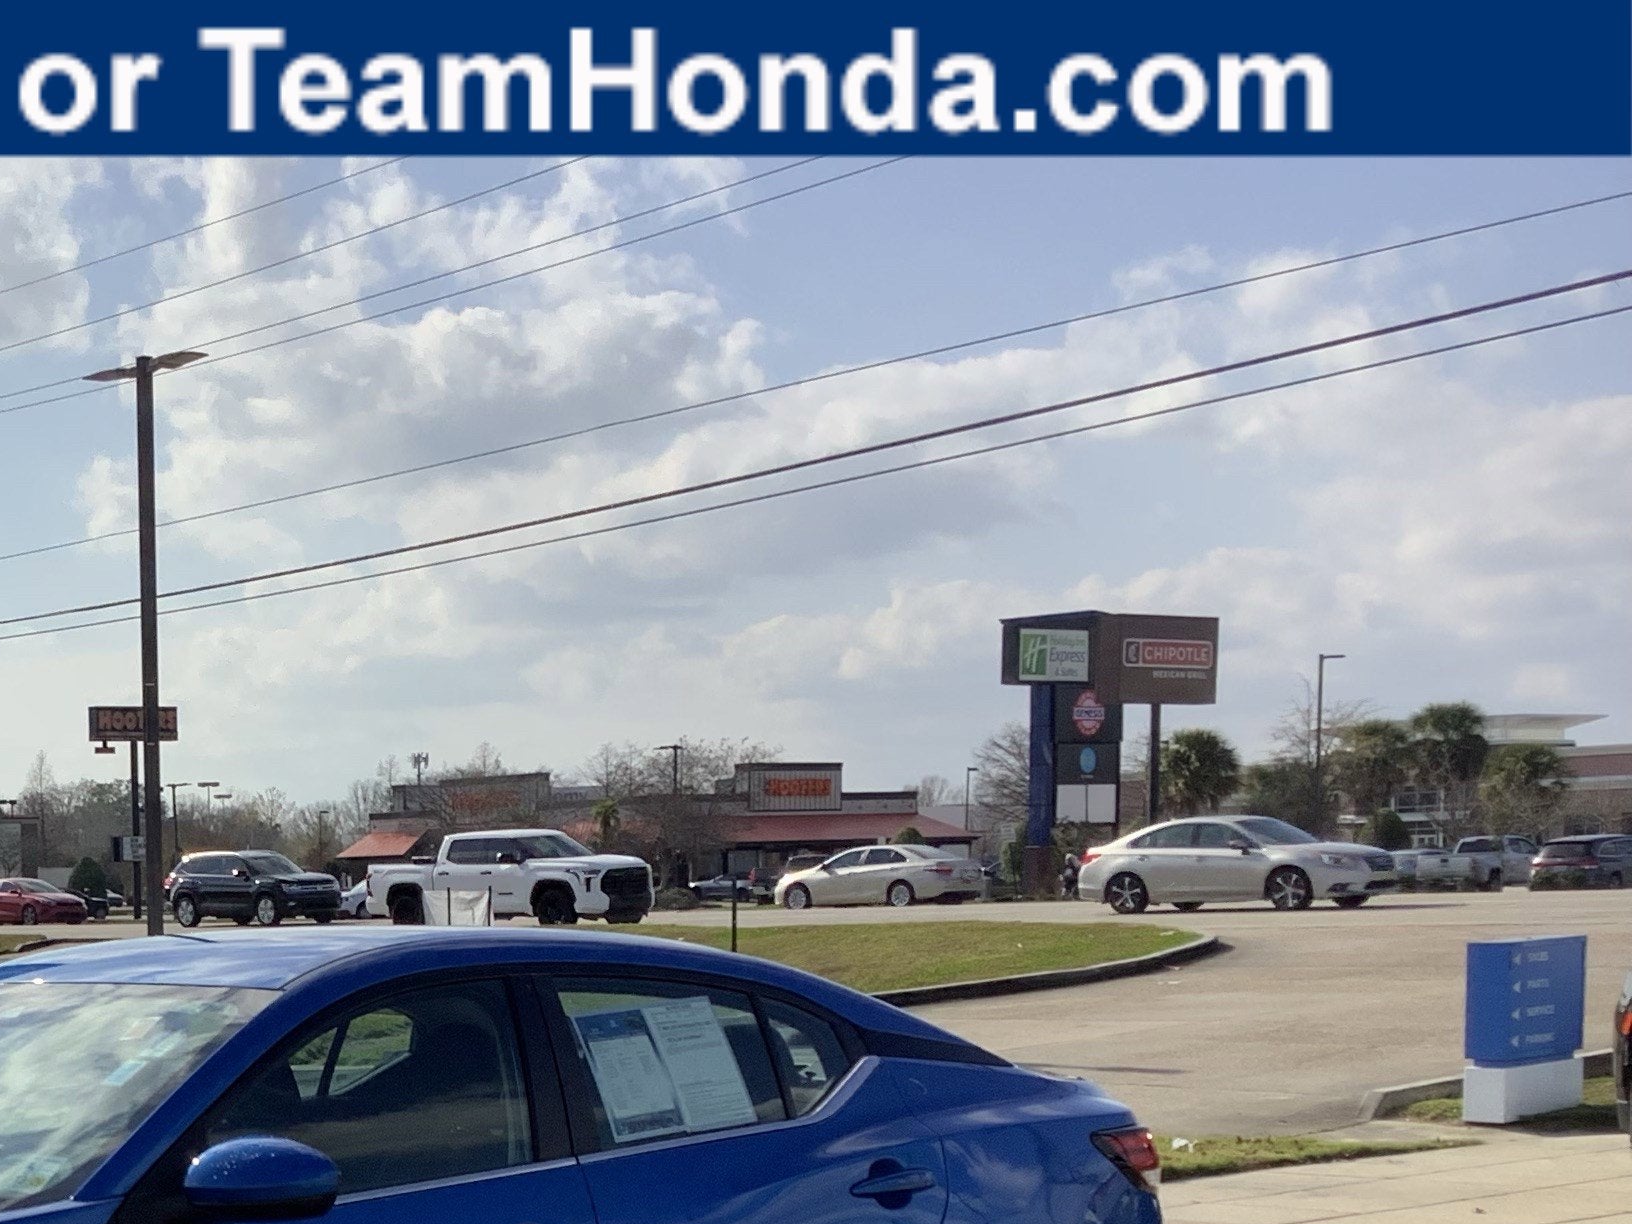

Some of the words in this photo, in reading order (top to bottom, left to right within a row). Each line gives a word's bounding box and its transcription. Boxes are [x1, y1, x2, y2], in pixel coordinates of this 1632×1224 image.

[1049, 647, 1086, 666] Express
[1144, 646, 1208, 662] CHIPOTLE
[1152, 670, 1185, 679] MEXICAN
[98, 709, 176, 731] HOOTRS
[1527, 1004, 1556, 1018] SERVICE
